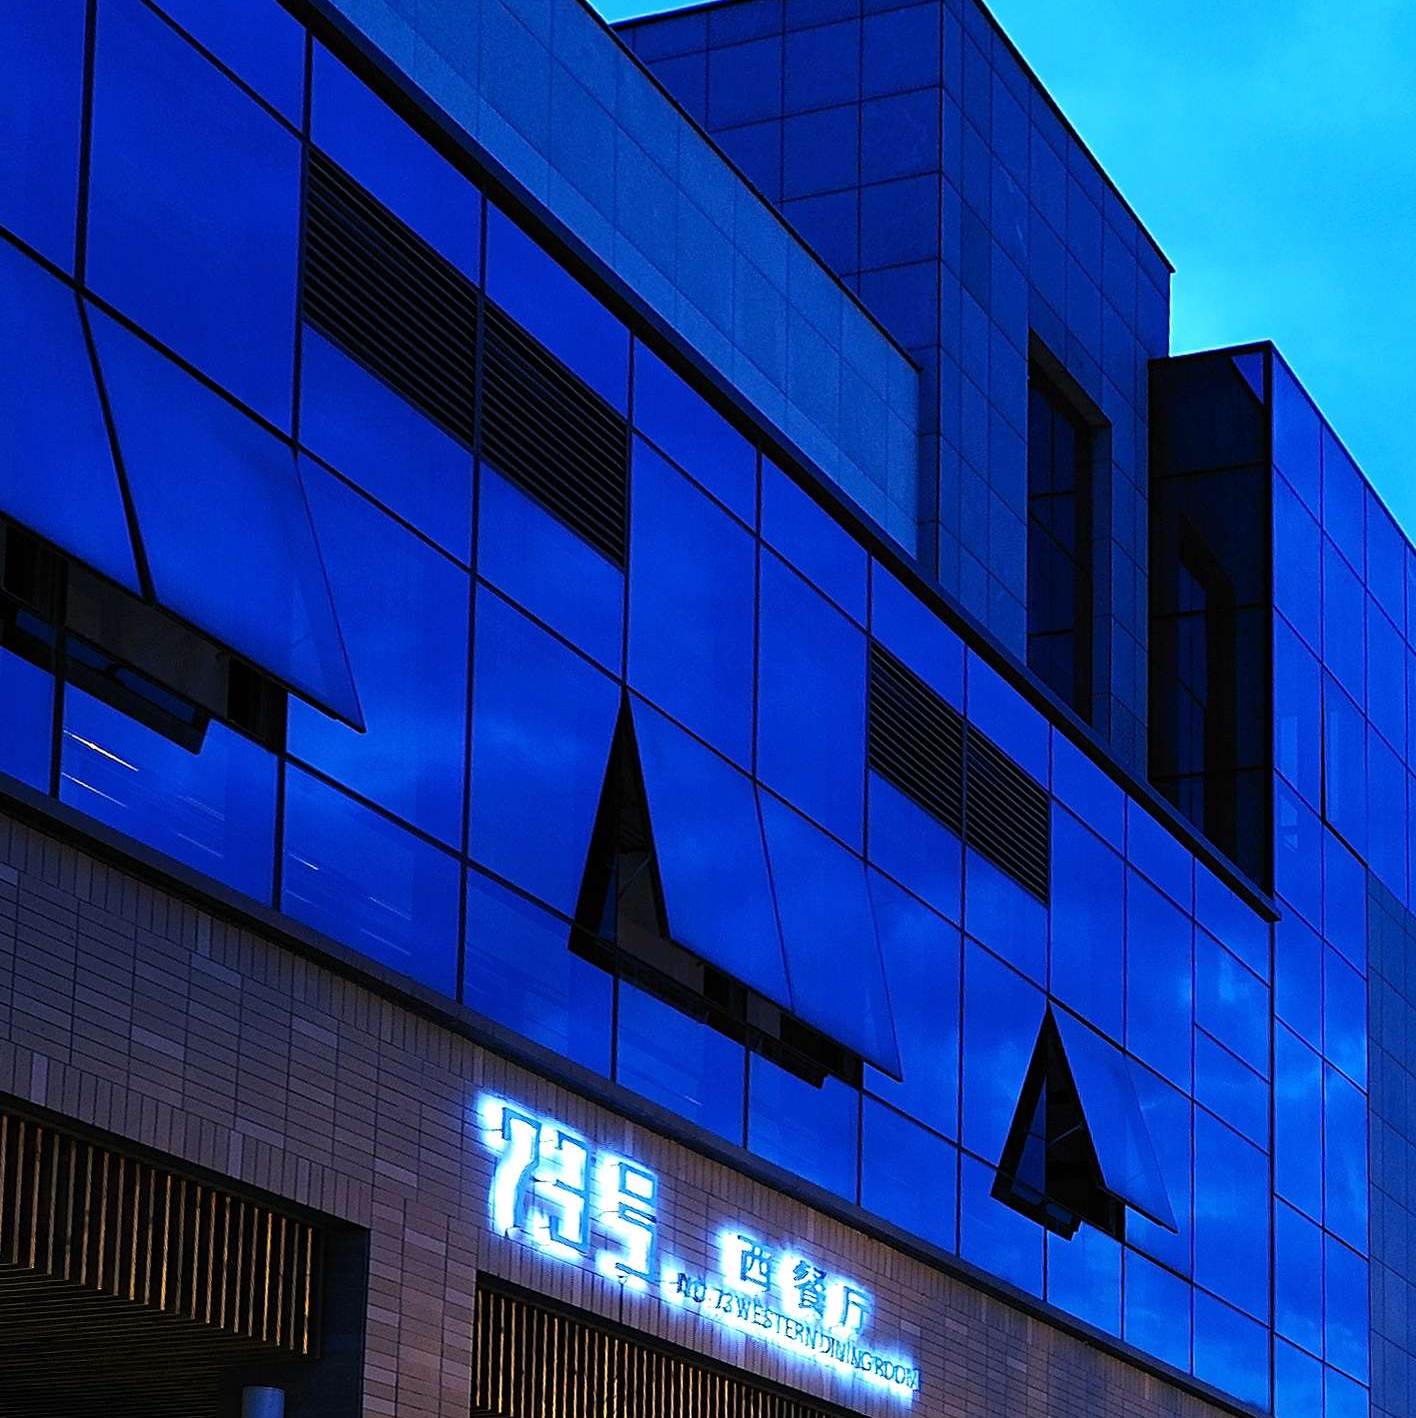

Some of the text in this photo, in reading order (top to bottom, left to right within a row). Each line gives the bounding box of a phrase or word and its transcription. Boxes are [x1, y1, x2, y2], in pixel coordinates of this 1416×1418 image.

[735, 1234, 873, 1333] 西餐厅
[734, 1294, 818, 1350] WESTERN
[819, 1332, 871, 1371] DINING
[872, 1355, 921, 1392] ROOM
